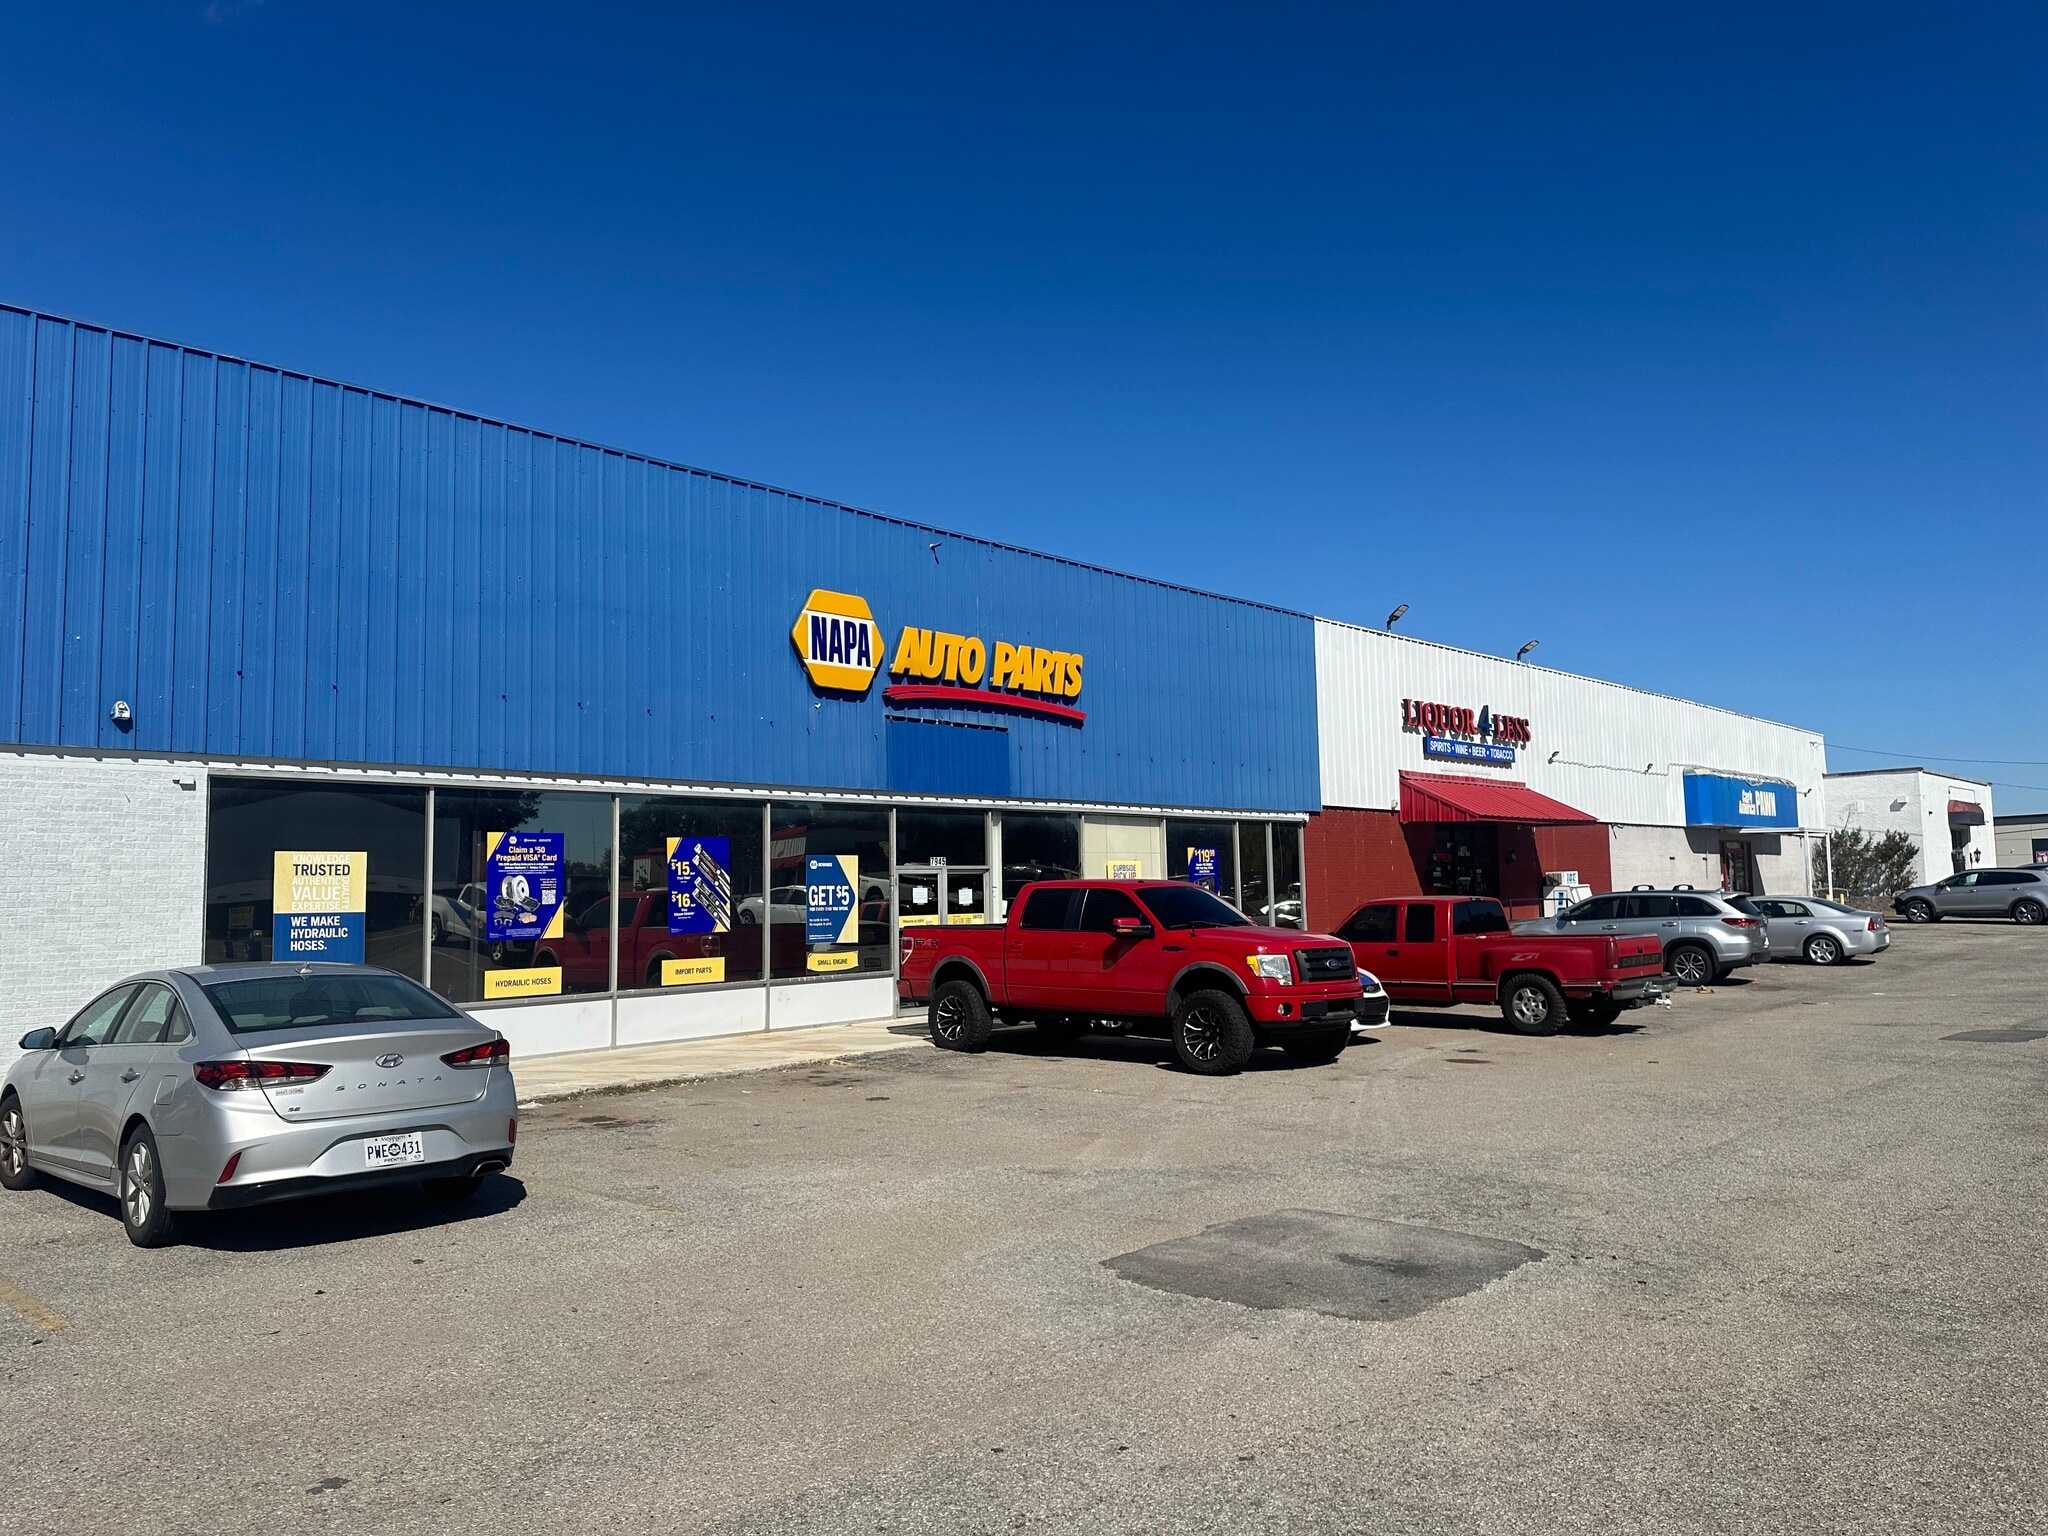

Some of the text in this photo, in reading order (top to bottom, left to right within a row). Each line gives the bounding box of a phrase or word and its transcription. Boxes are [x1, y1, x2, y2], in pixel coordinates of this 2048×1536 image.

[811, 615, 871, 667] NAPA
[892, 626, 1084, 697] AUTO PARTS
[1402, 698, 1532, 742] LIQUOR 4 LESS
[1430, 740, 1513, 761] SPIRITS WINE BEER TOBACCO
[1754, 790, 1777, 817] PAWN
[508, 845, 528, 854] Claim
[292, 854, 351, 864] KNOWLEDGE
[496, 854, 522, 863] Prepaid
[292, 863, 351, 876] TRUSTED
[671, 861, 691, 876] $15
[291, 876, 341, 886] AUTHENTIC
[291, 886, 341, 901] VALUE
[808, 885, 850, 906] GET $5
[291, 901, 341, 911] EXPERTISE
[671, 893, 691, 908] $16
[290, 915, 341, 927] WE MAKE
[290, 927, 349, 939] HYDRAULIC
[290, 940, 328, 952] HOSES.
[1622, 954, 1661, 967] CHEVROLET
[675, 966, 713, 976] IMPORT PARTS
[495, 977, 552, 988] HYDRAULIC HOSES
[335, 1075, 443, 1092] SONATA
[367, 1140, 422, 1160] PWE 431
